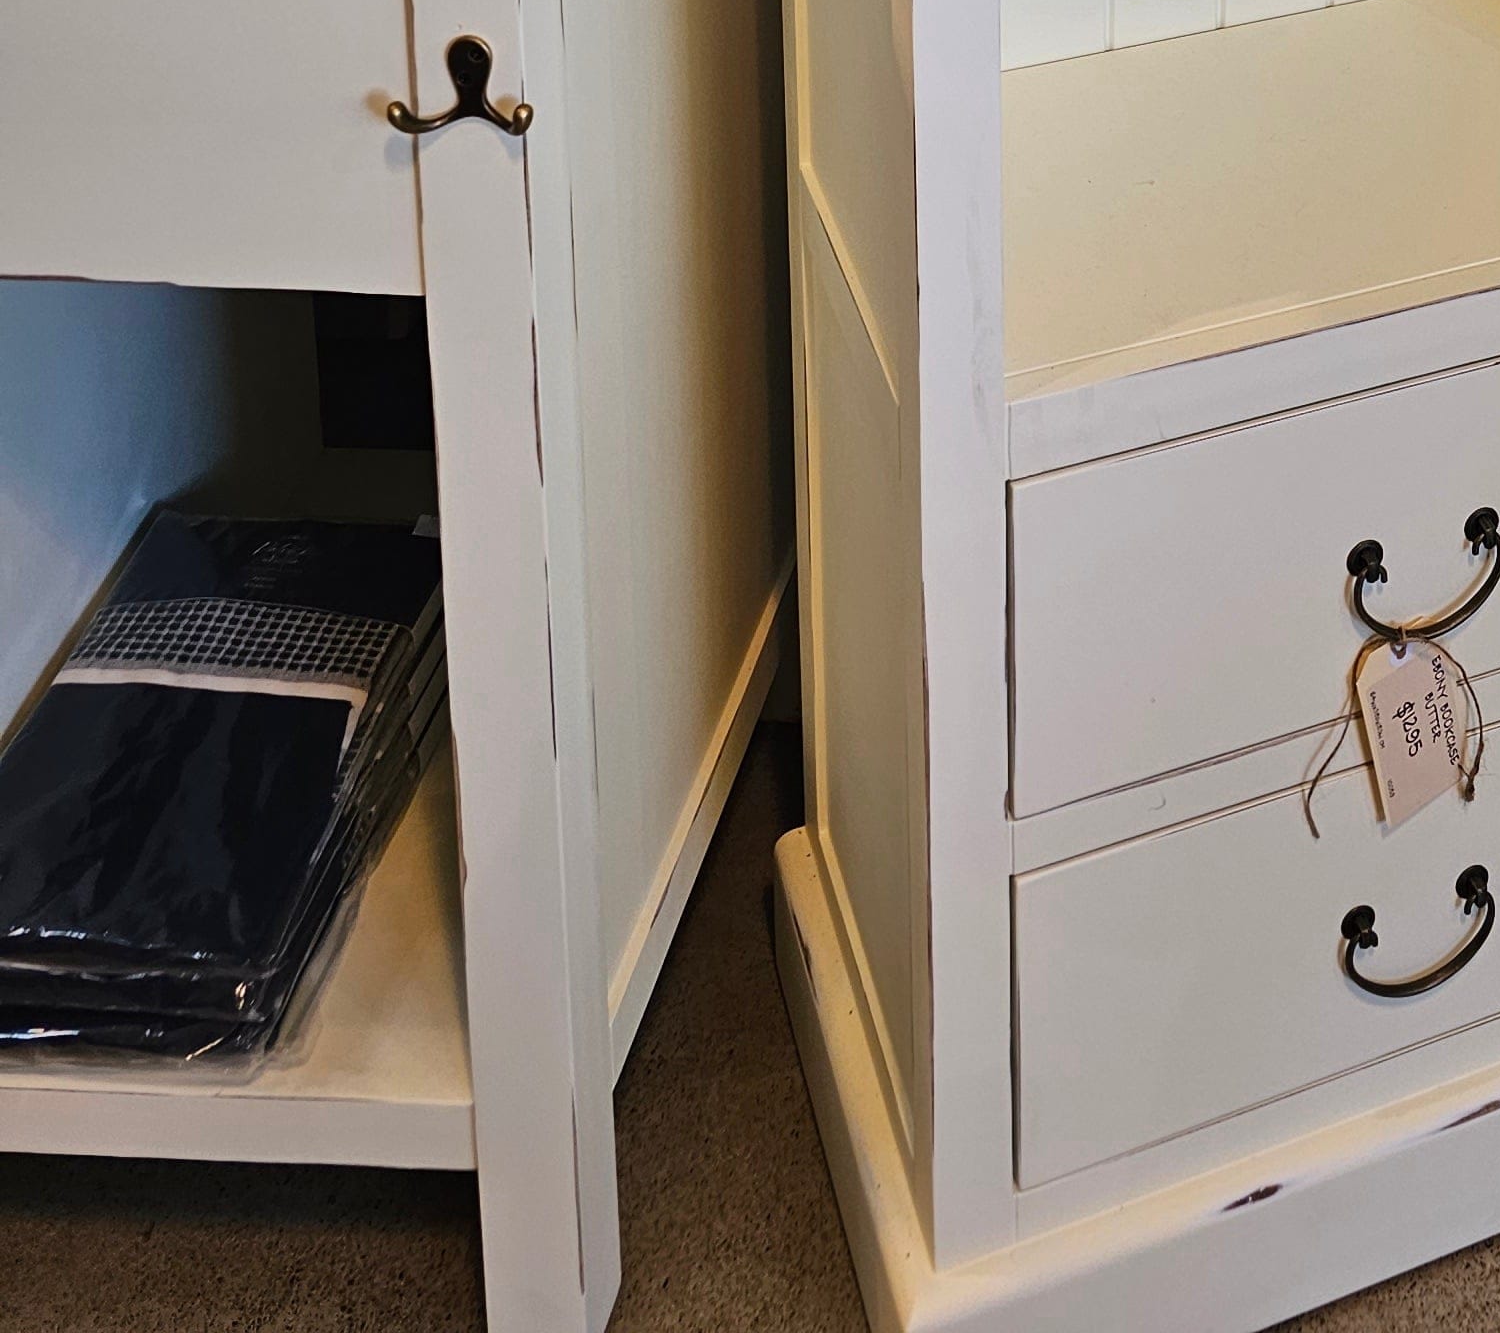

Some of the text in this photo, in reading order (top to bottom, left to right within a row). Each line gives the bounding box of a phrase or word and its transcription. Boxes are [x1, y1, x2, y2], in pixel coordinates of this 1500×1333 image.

[1392, 701, 1423, 757] $1295
[1424, 692, 1441, 743] BUTTER
[1431, 654, 1460, 766] EBONY BOOKCASE
